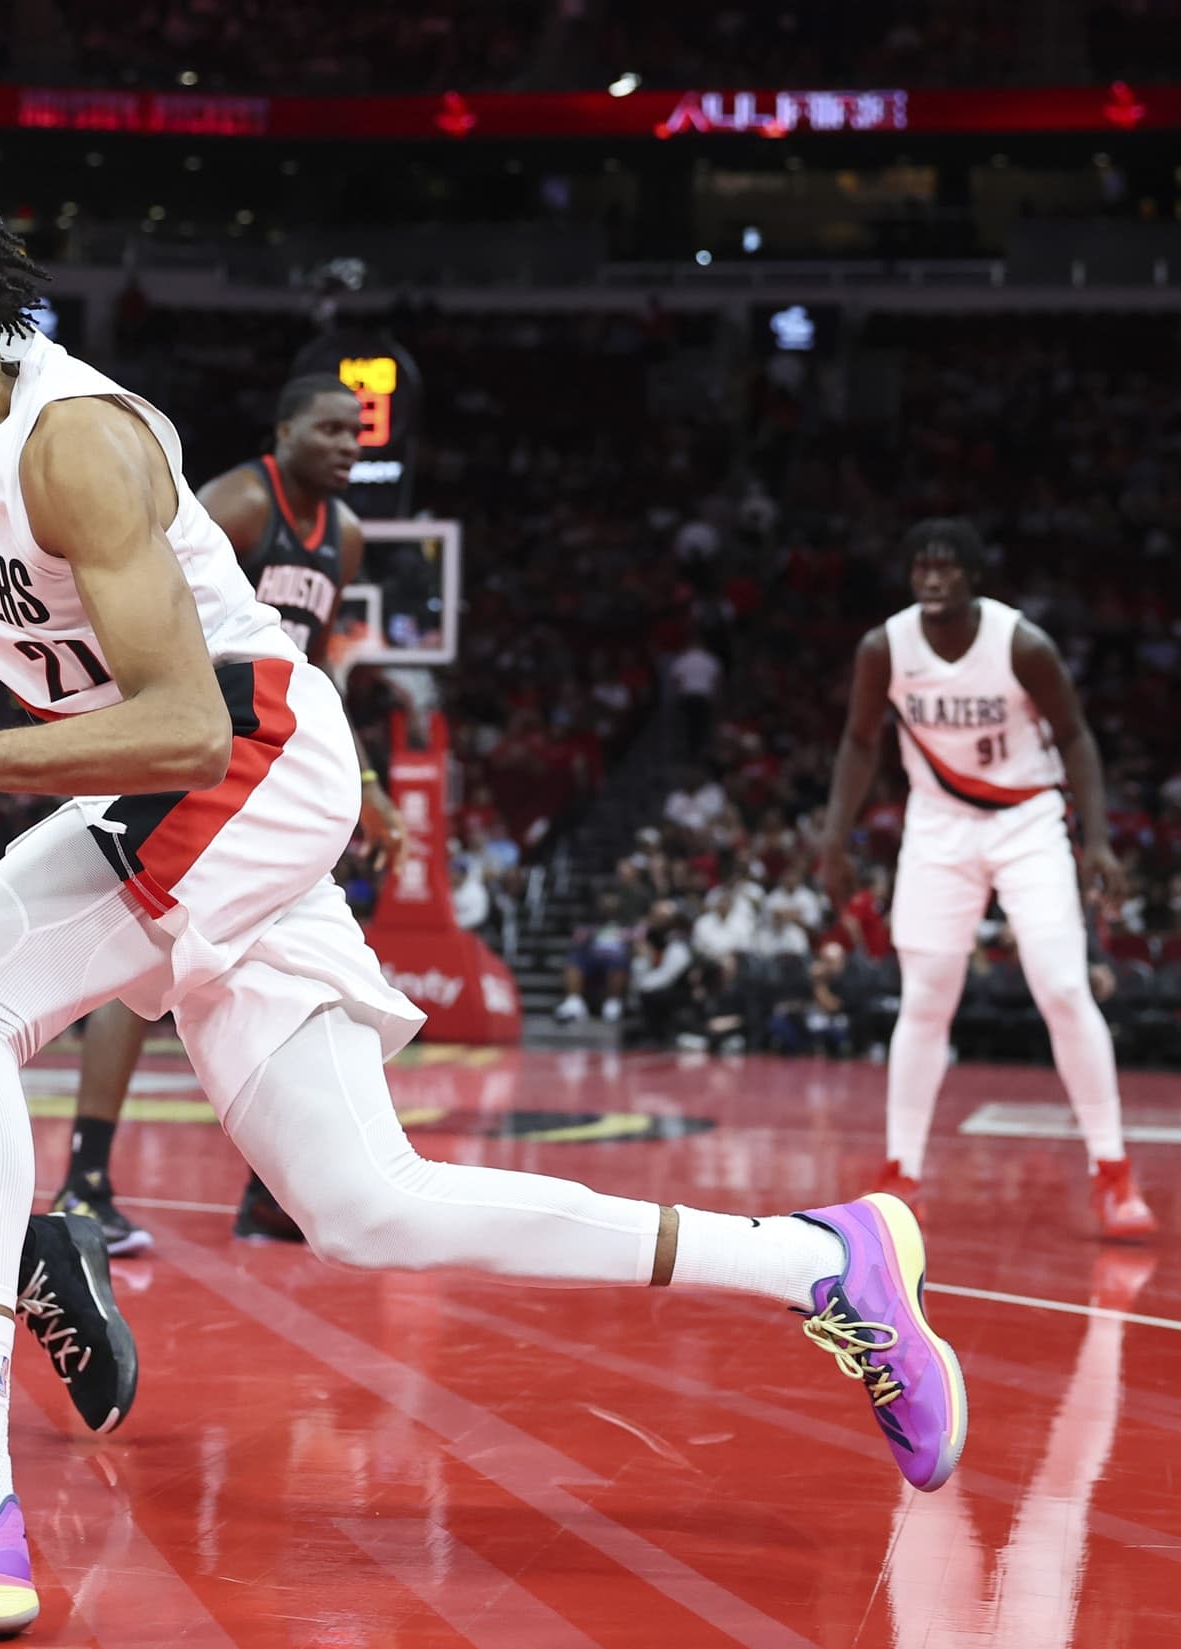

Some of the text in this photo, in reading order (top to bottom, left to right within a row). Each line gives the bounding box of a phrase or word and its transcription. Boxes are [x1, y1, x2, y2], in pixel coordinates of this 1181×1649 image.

[14, 639, 113, 703] 21
[905, 693, 1007, 728] BLAZERS
[976, 732, 1008, 768] 91
